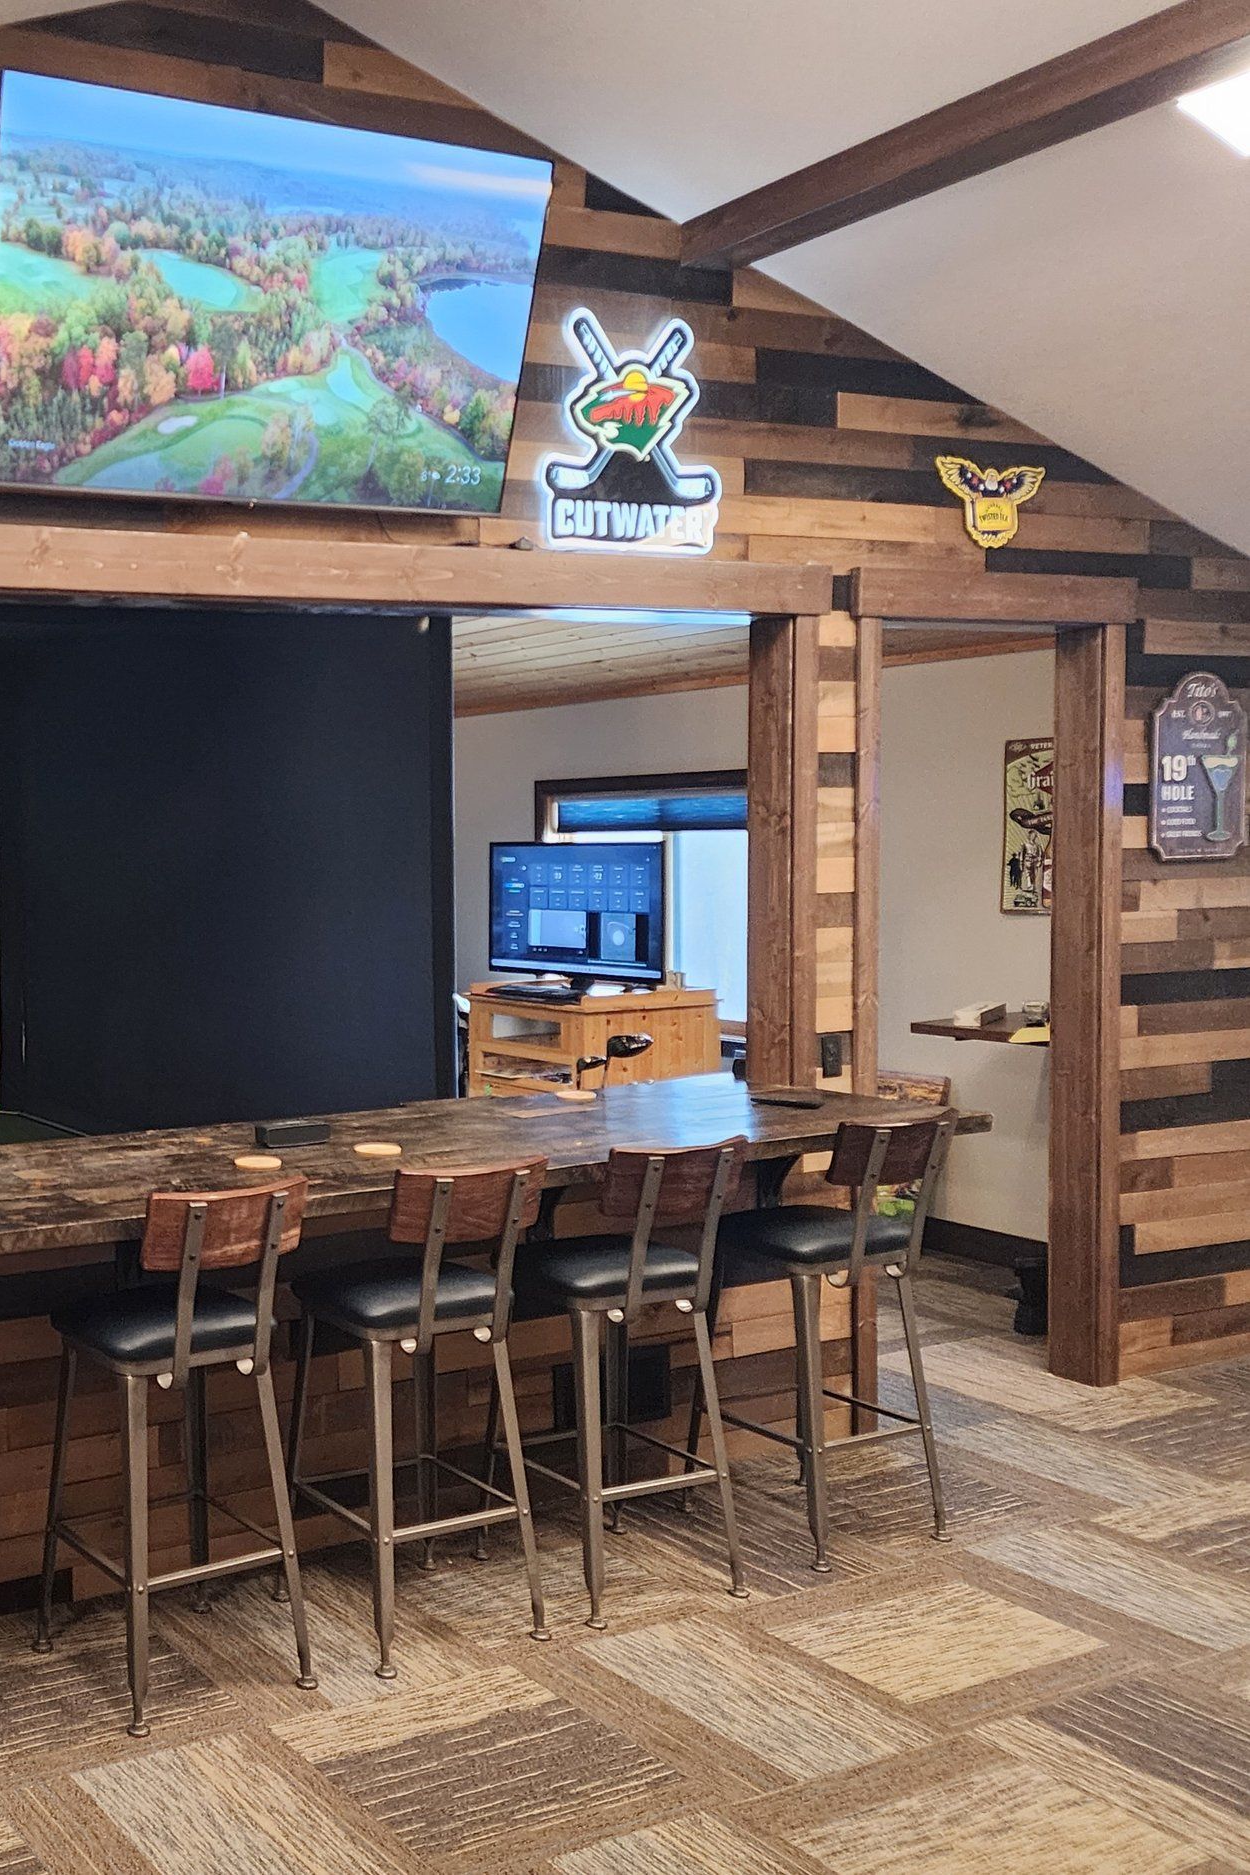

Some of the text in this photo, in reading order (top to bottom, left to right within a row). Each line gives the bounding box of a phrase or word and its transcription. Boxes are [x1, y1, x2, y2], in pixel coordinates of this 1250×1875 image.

[445, 465, 481, 485] 2:33
[554, 498, 705, 540] CUTWATER
[1187, 682, 1219, 698] Tito's
[1161, 785, 1195, 801] HOLE
